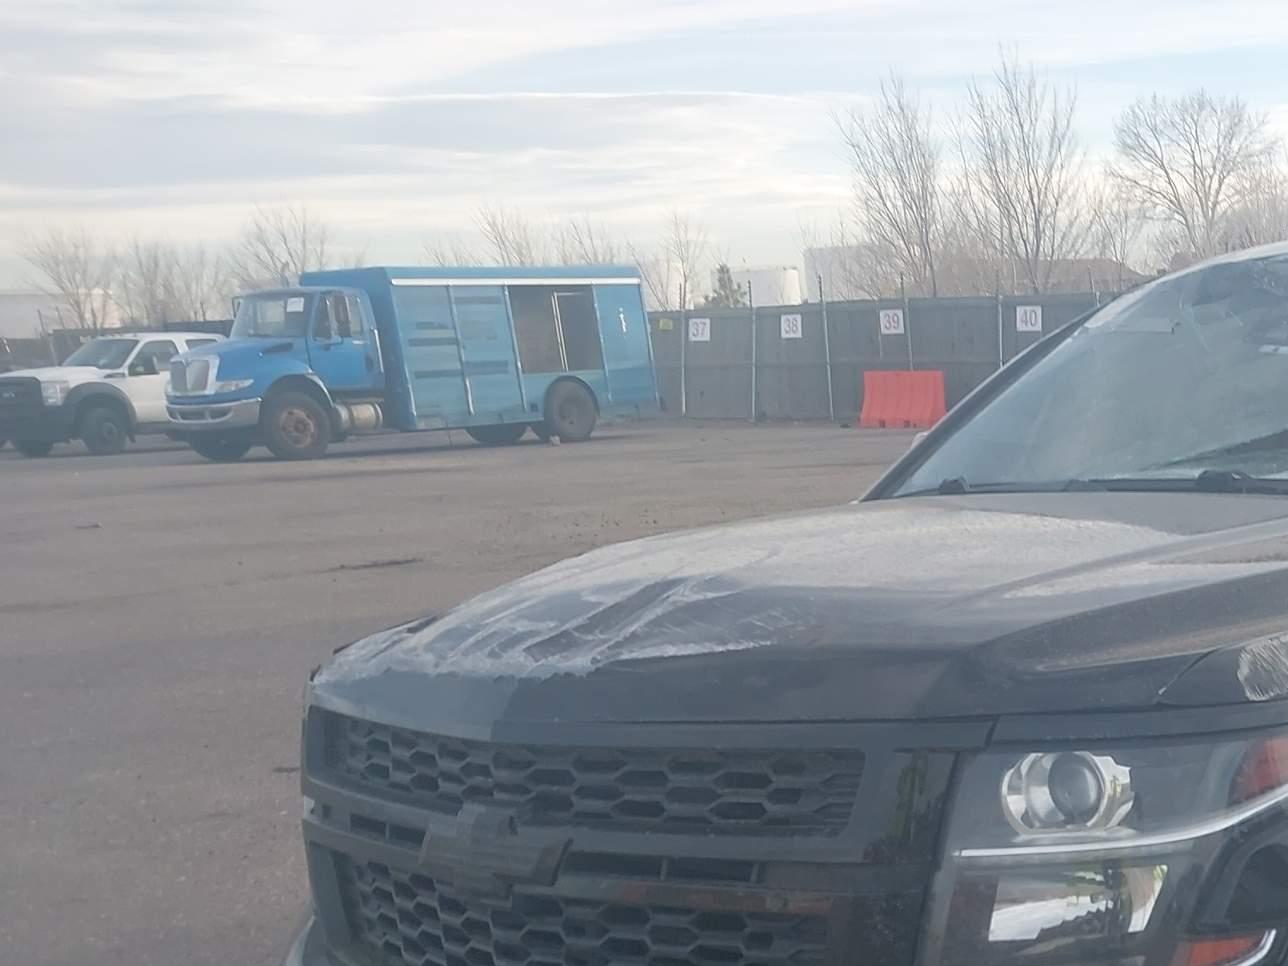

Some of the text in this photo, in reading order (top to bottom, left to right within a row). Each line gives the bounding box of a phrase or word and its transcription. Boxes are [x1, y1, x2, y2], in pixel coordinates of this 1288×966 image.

[783, 317, 799, 335] 38
[884, 312, 900, 331] 39
[1020, 309, 1038, 328] 40
[691, 320, 707, 338] 37
